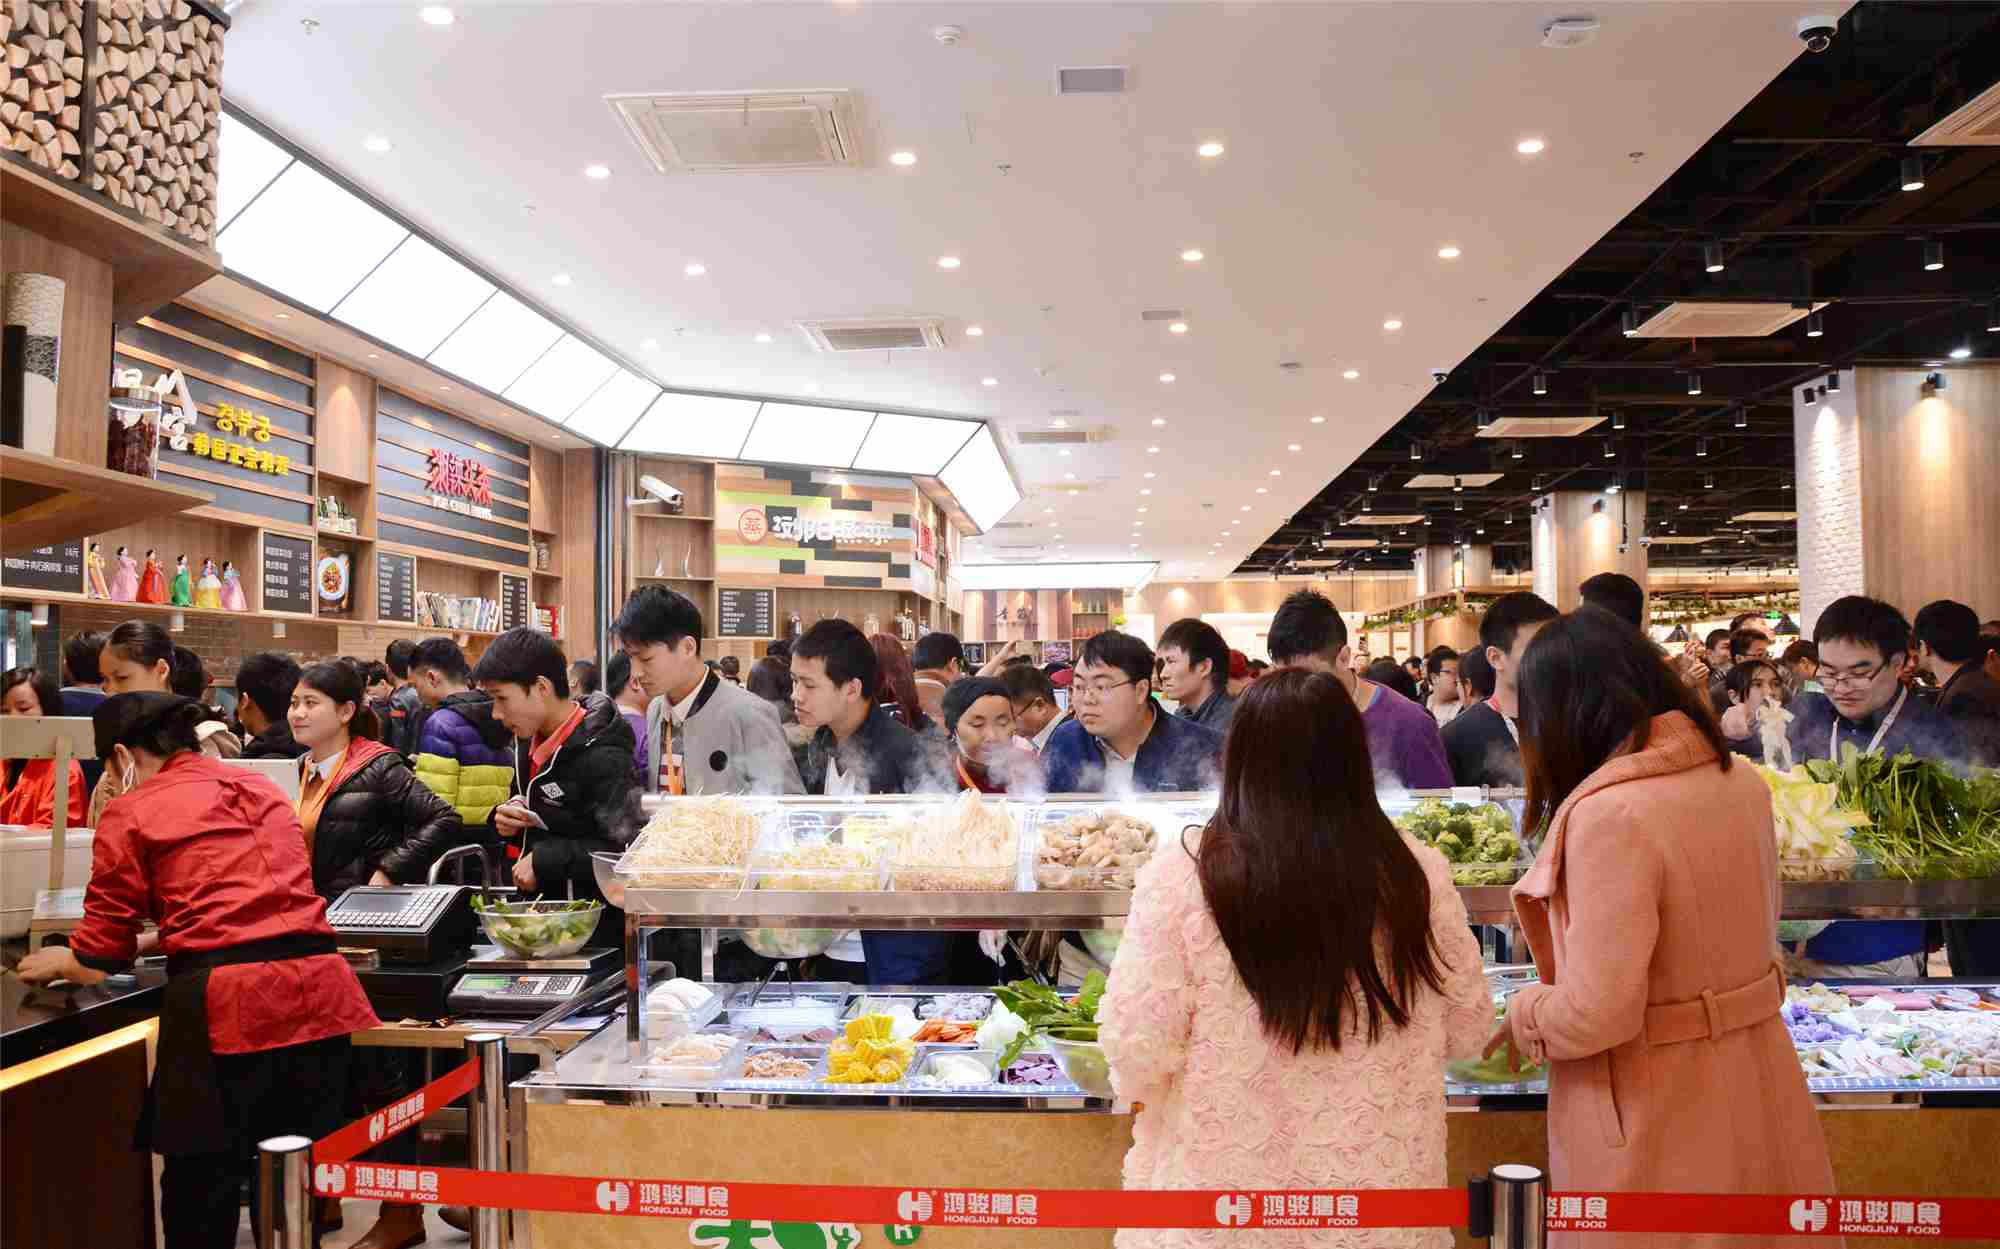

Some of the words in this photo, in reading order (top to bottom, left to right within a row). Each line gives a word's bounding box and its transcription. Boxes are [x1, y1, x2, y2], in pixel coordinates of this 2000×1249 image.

[355, 1166, 438, 1192] 鸿骏膳食
[355, 1187, 404, 1199] HONGJUN
[411, 1191, 438, 1200] FOOD
[640, 1183, 728, 1207] 鸿骏膳食
[943, 1192, 1037, 1215] 鸿骏膳食
[1263, 1195, 1359, 1216] 鸿骏膳食
[640, 1205, 692, 1215] HONGJUN
[699, 1207, 729, 1216] FOOD
[1839, 1200, 1941, 1224] 鸿骏膳食
[943, 1215, 999, 1224] HONGJUN
[1007, 1216, 1037, 1225] FOOD
[1263, 1217, 1319, 1225] HONGJUN
[1327, 1217, 1359, 1226] FOOD
[1575, 1220, 1607, 1229] FOOD
[1839, 1225, 1899, 1234] HONGJUN
[1906, 1225, 1941, 1235] FOOD
